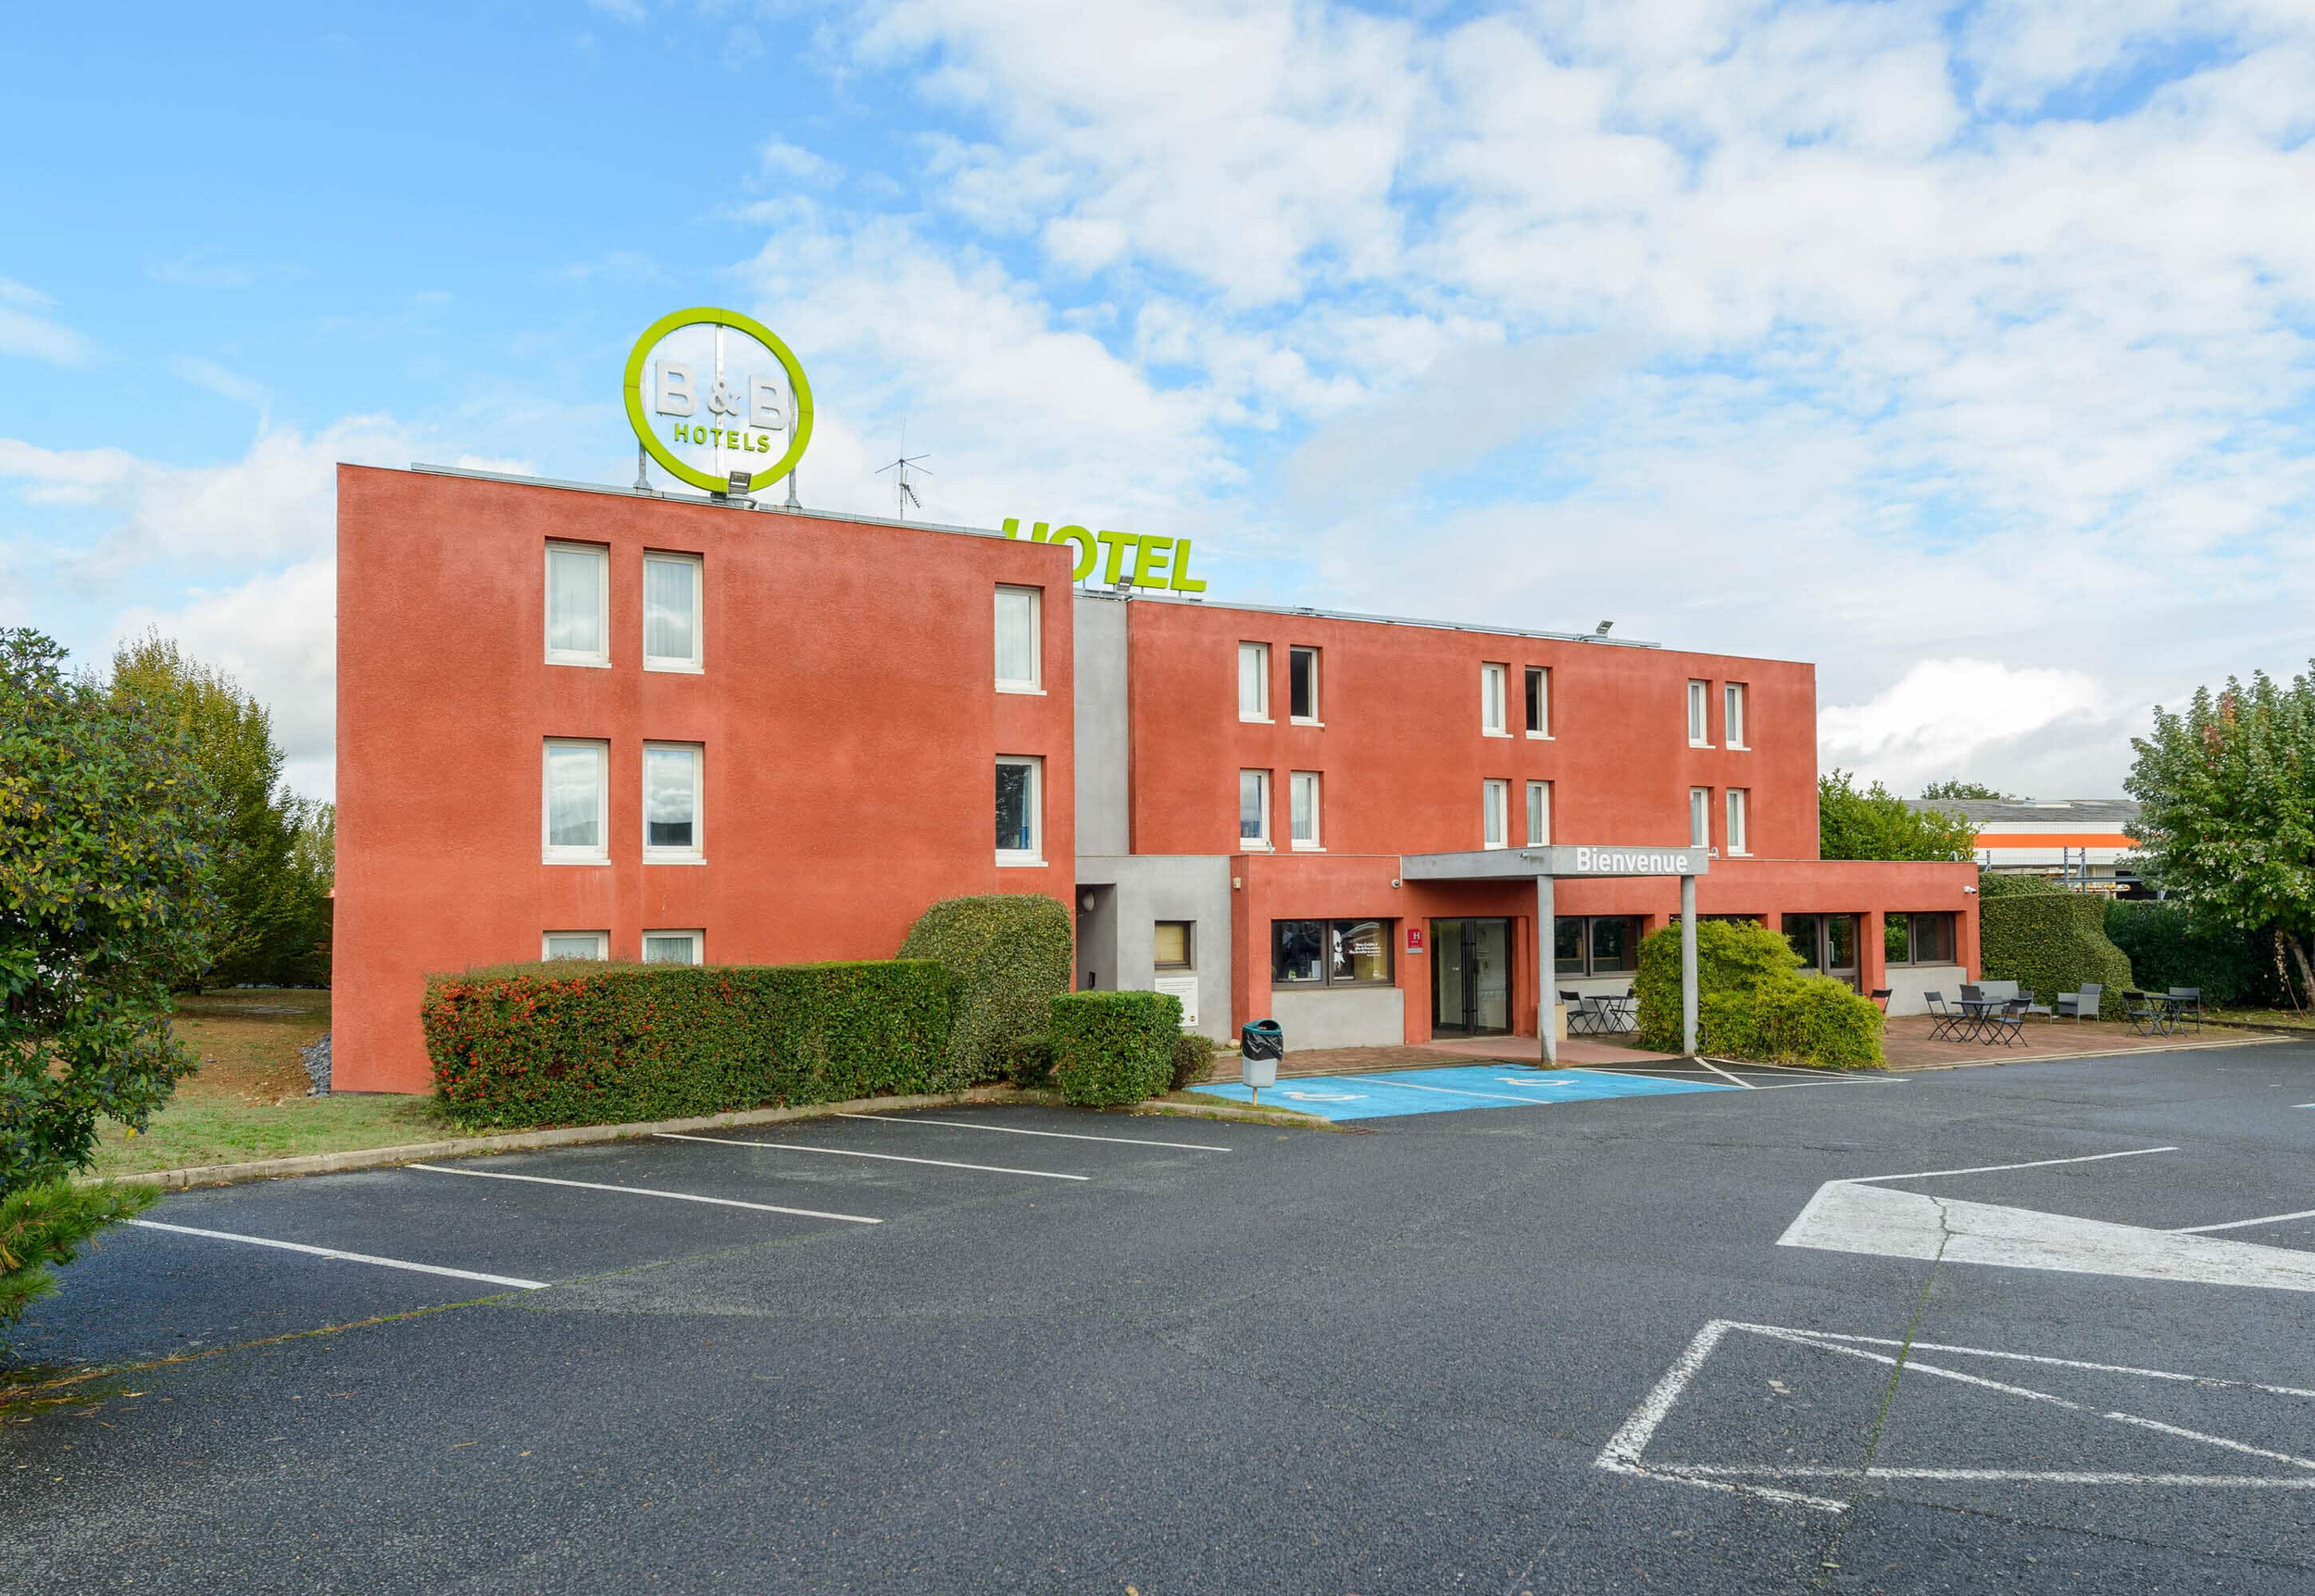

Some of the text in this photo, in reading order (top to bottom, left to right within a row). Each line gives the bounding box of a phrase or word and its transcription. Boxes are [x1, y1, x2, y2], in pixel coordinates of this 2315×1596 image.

[674, 422, 770, 453] HOTELS
[1576, 847, 1688, 873] Bienvenue
[1413, 931, 1420, 940] H
